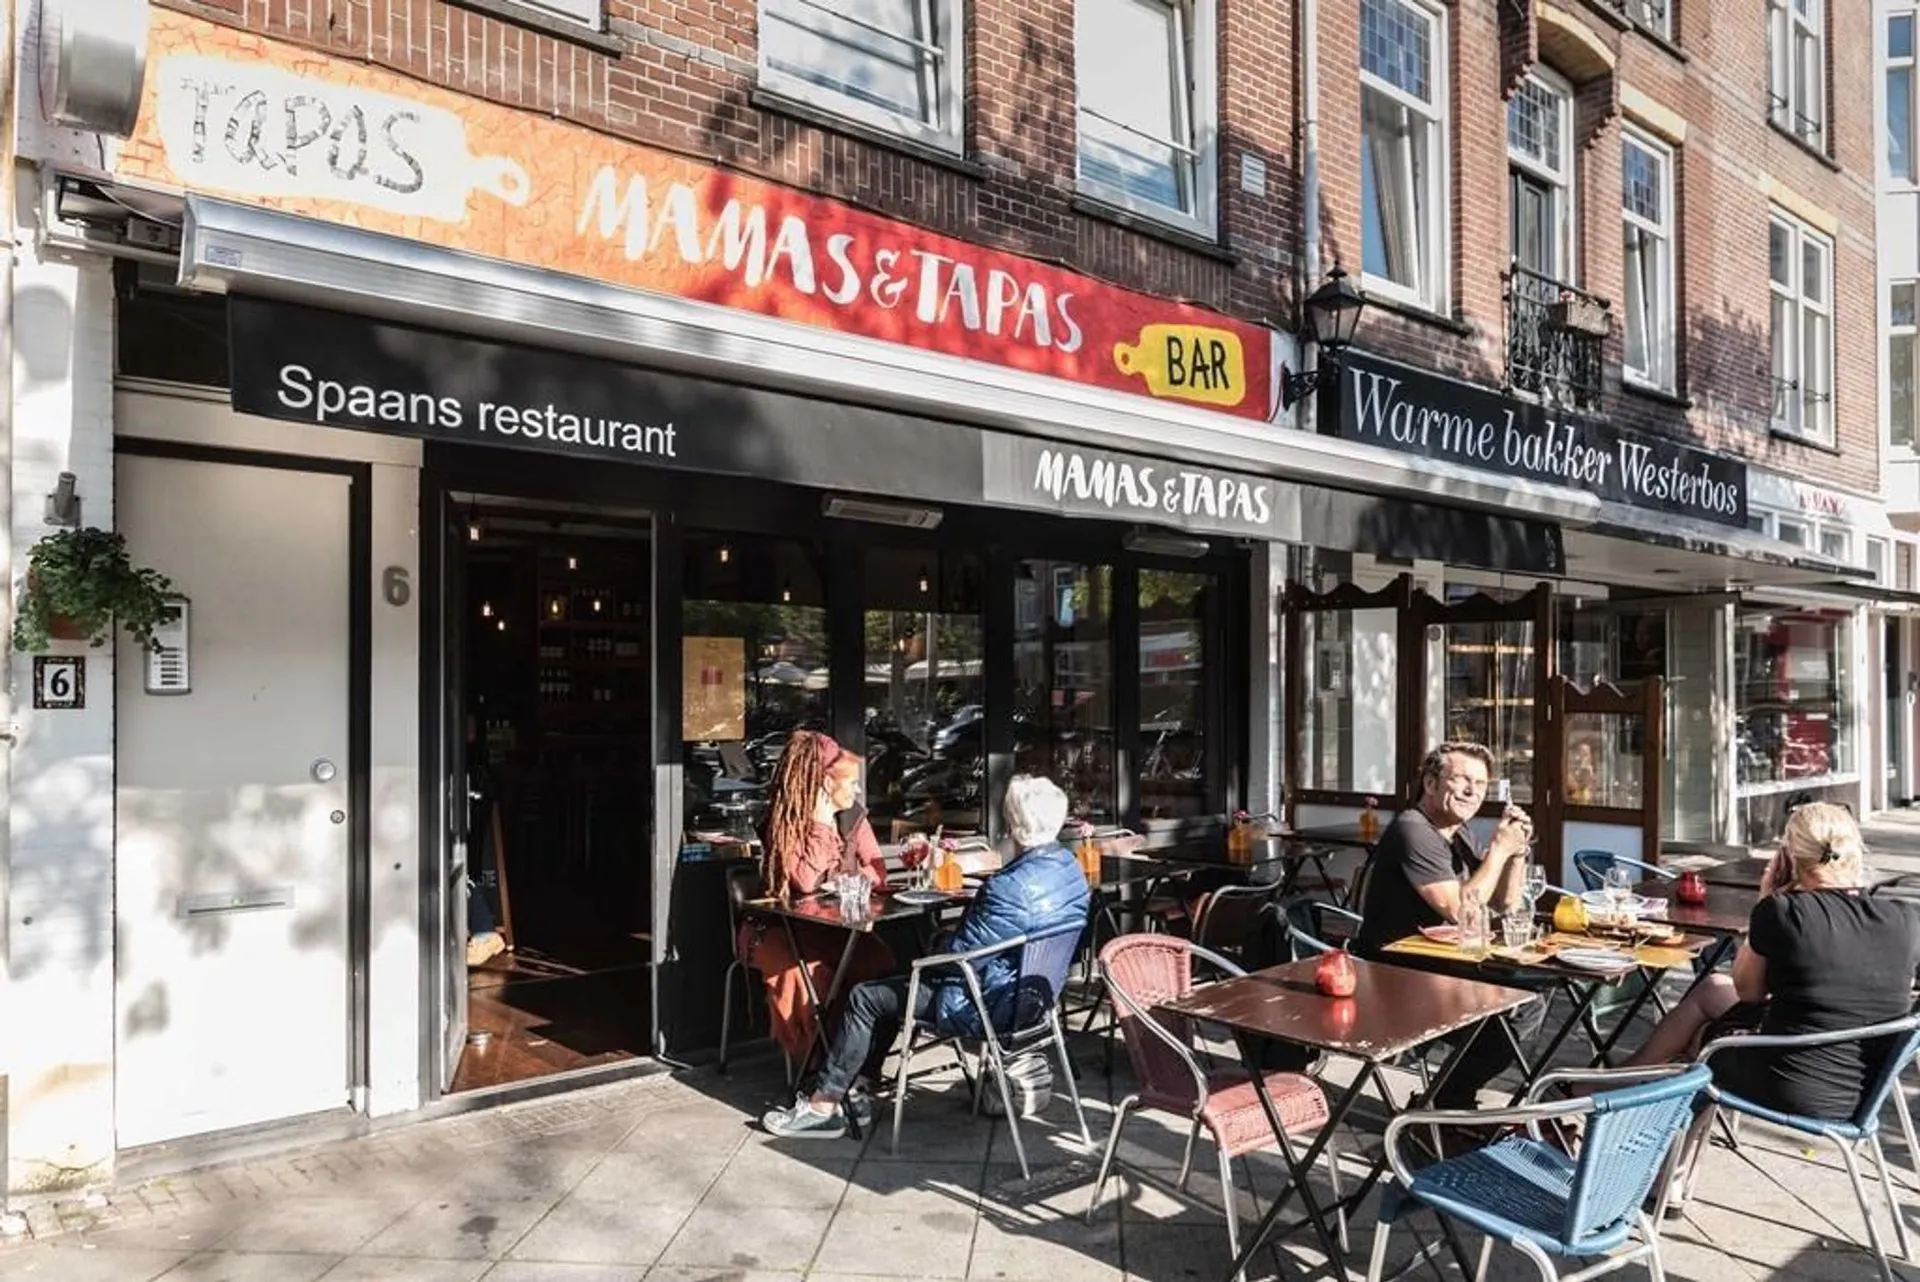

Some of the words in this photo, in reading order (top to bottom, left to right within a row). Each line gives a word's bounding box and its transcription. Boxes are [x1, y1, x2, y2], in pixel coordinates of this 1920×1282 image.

[1167, 336, 1230, 390] BAR
[277, 364, 463, 429] Spaans
[478, 402, 677, 458] restaurant
[1349, 368, 1496, 459] Warme
[1503, 411, 1612, 484] bakker
[1617, 440, 1739, 516] Westerbos
[382, 566, 411, 606] 6
[51, 668, 69, 696] 6
